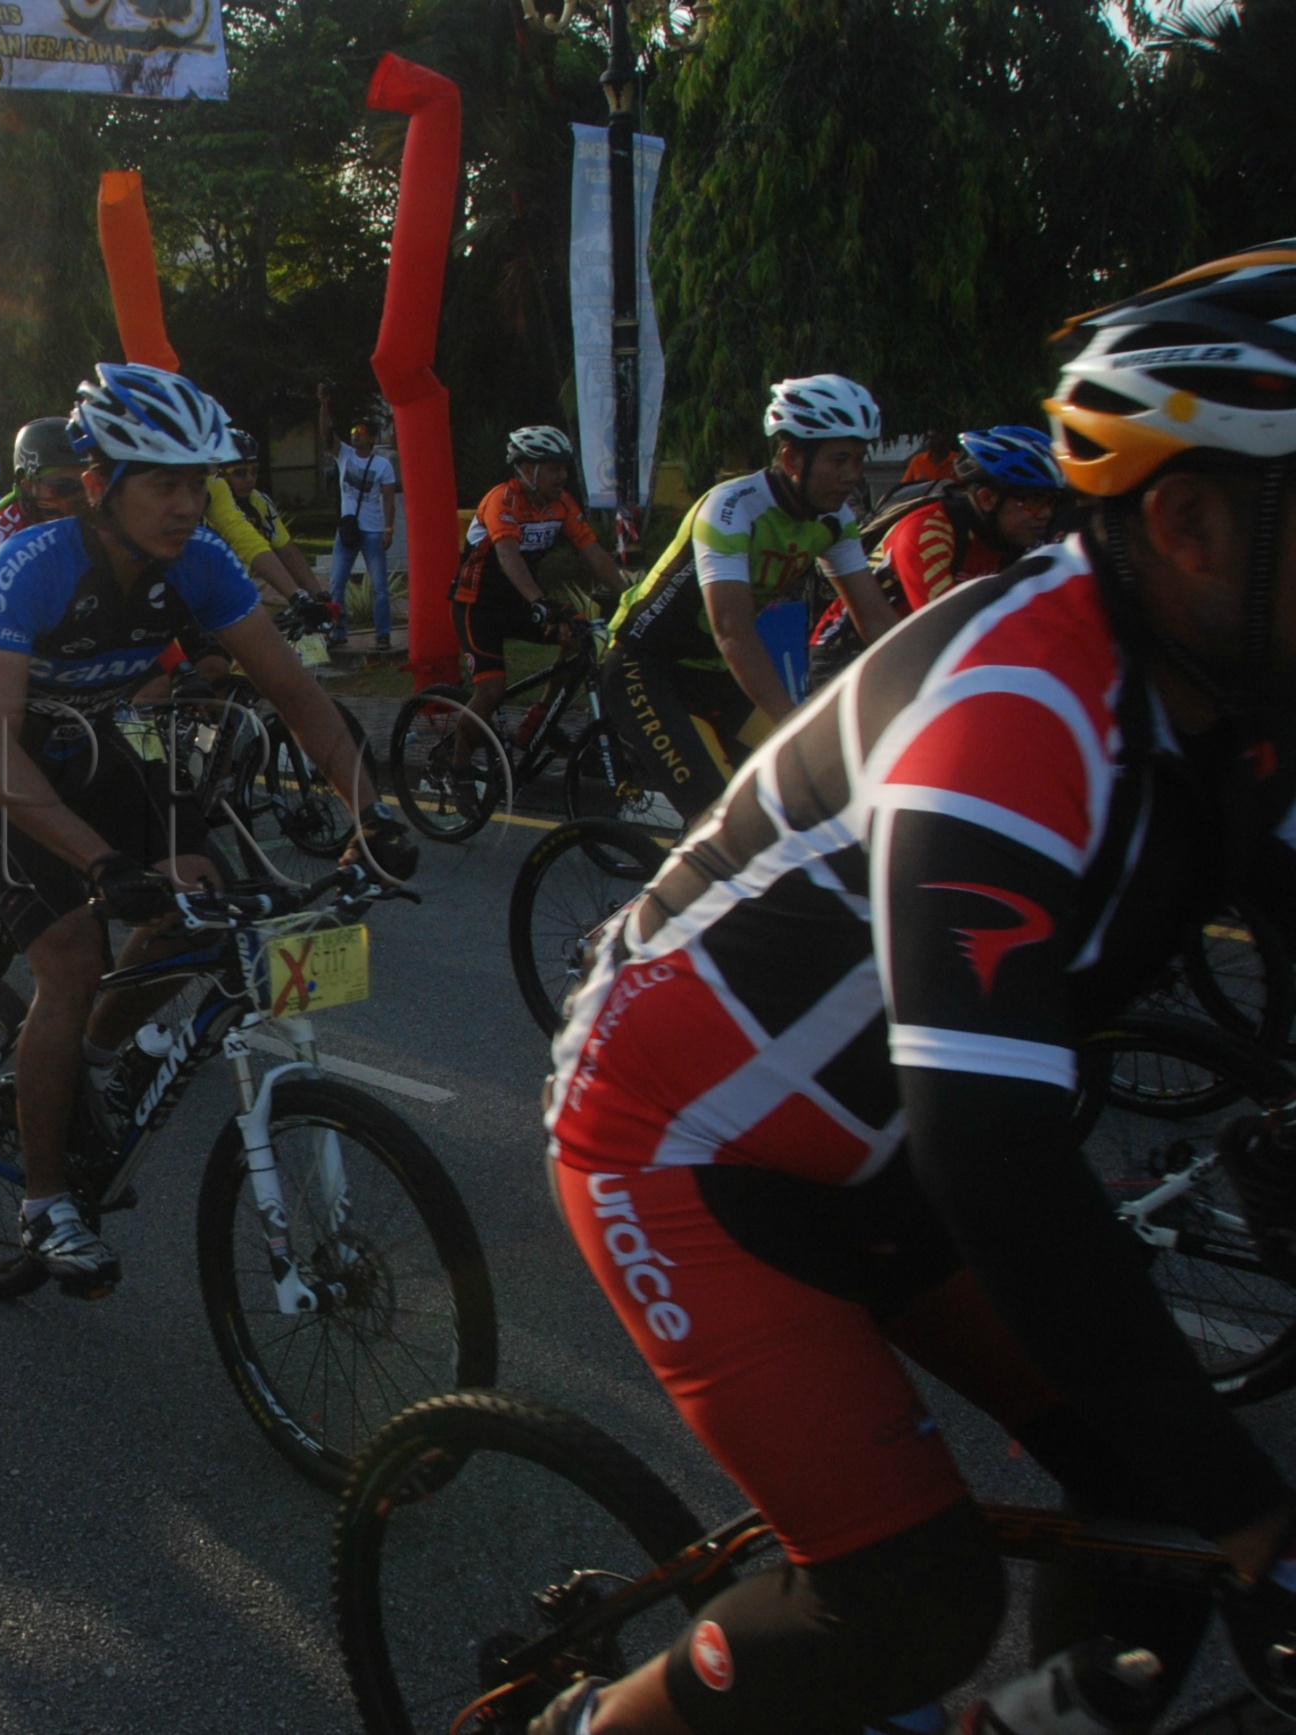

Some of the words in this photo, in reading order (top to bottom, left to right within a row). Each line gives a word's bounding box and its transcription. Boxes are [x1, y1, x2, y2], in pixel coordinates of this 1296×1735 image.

[25, 35, 128, 64] KERJASAMA
[621, 653, 691, 784] IVESTRONG
[567, 963, 675, 1113] PINARELLO
